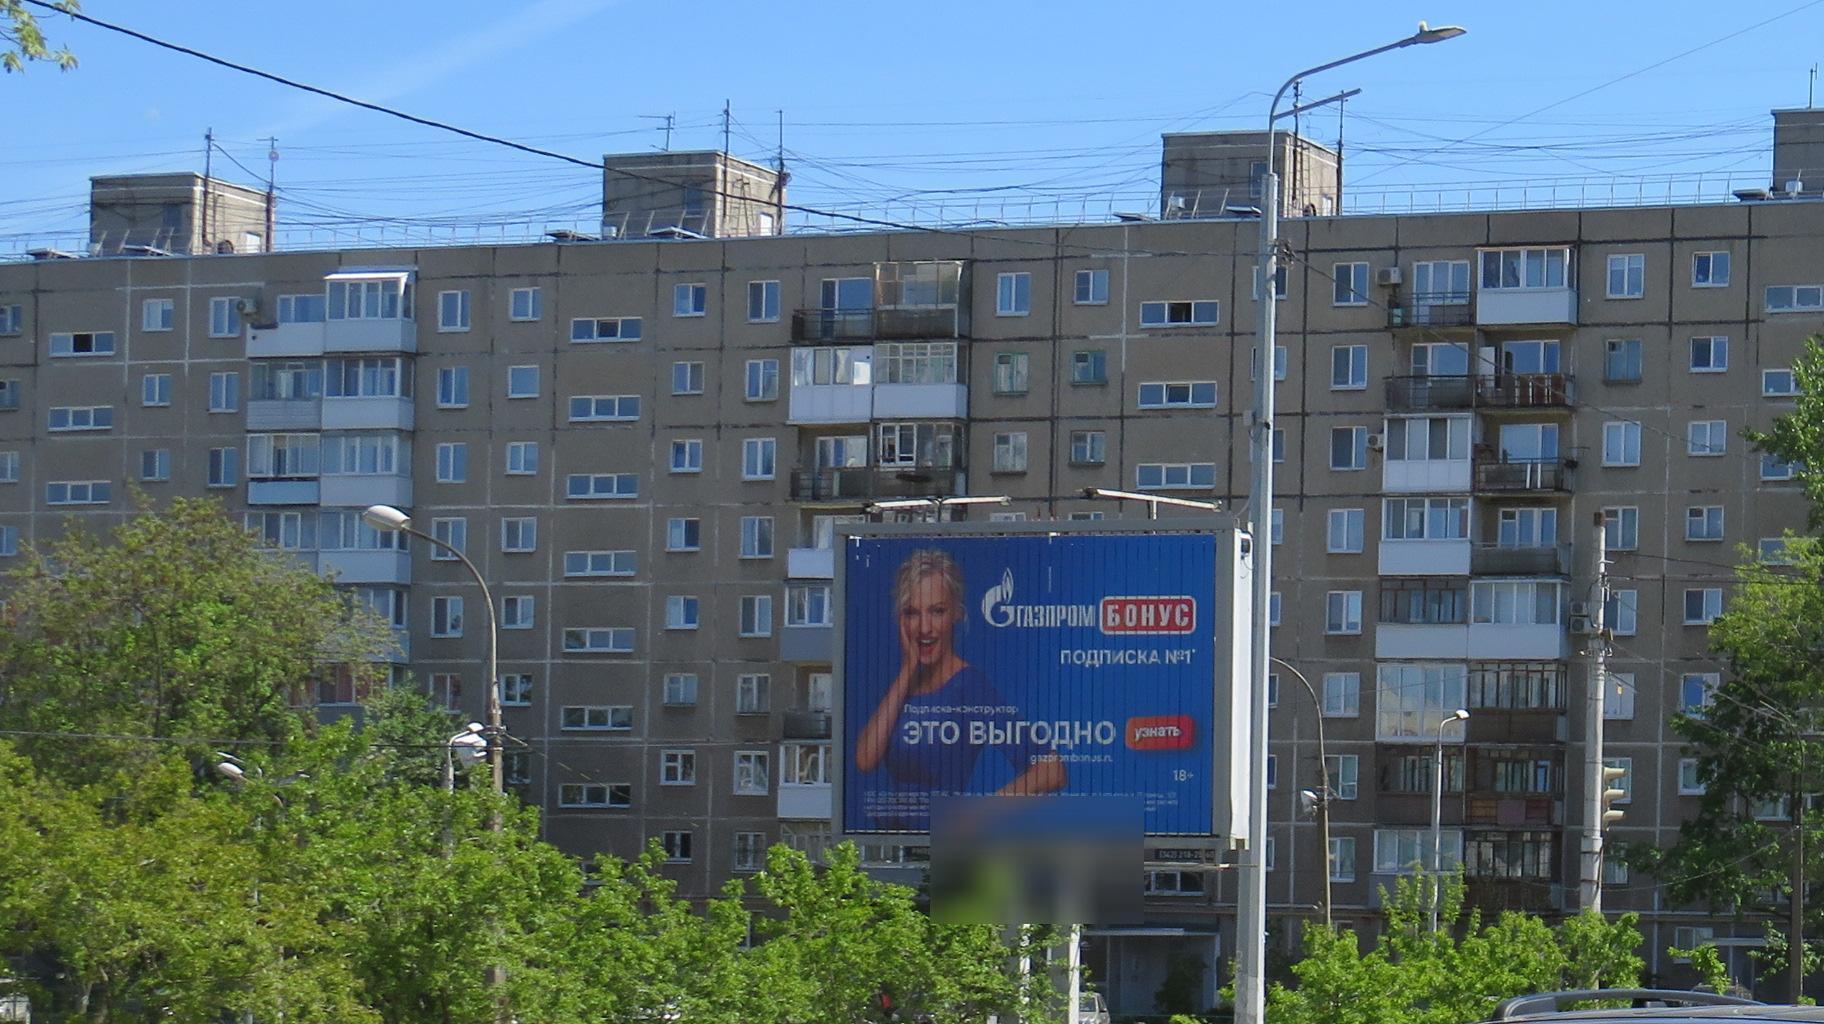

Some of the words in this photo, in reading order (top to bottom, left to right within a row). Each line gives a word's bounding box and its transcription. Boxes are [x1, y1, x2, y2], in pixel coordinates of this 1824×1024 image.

[1016, 604, 1096, 628] ГАЗПРОМ
[1106, 603, 1190, 627] БОНУС
[1060, 649, 1161, 667] ПОДПИСКА
[903, 720, 960, 745] ЭТО
[969, 720, 1116, 749] ВЫГОДНО
[1134, 725, 1182, 740] узнать
[1172, 769, 1194, 781] 18+
